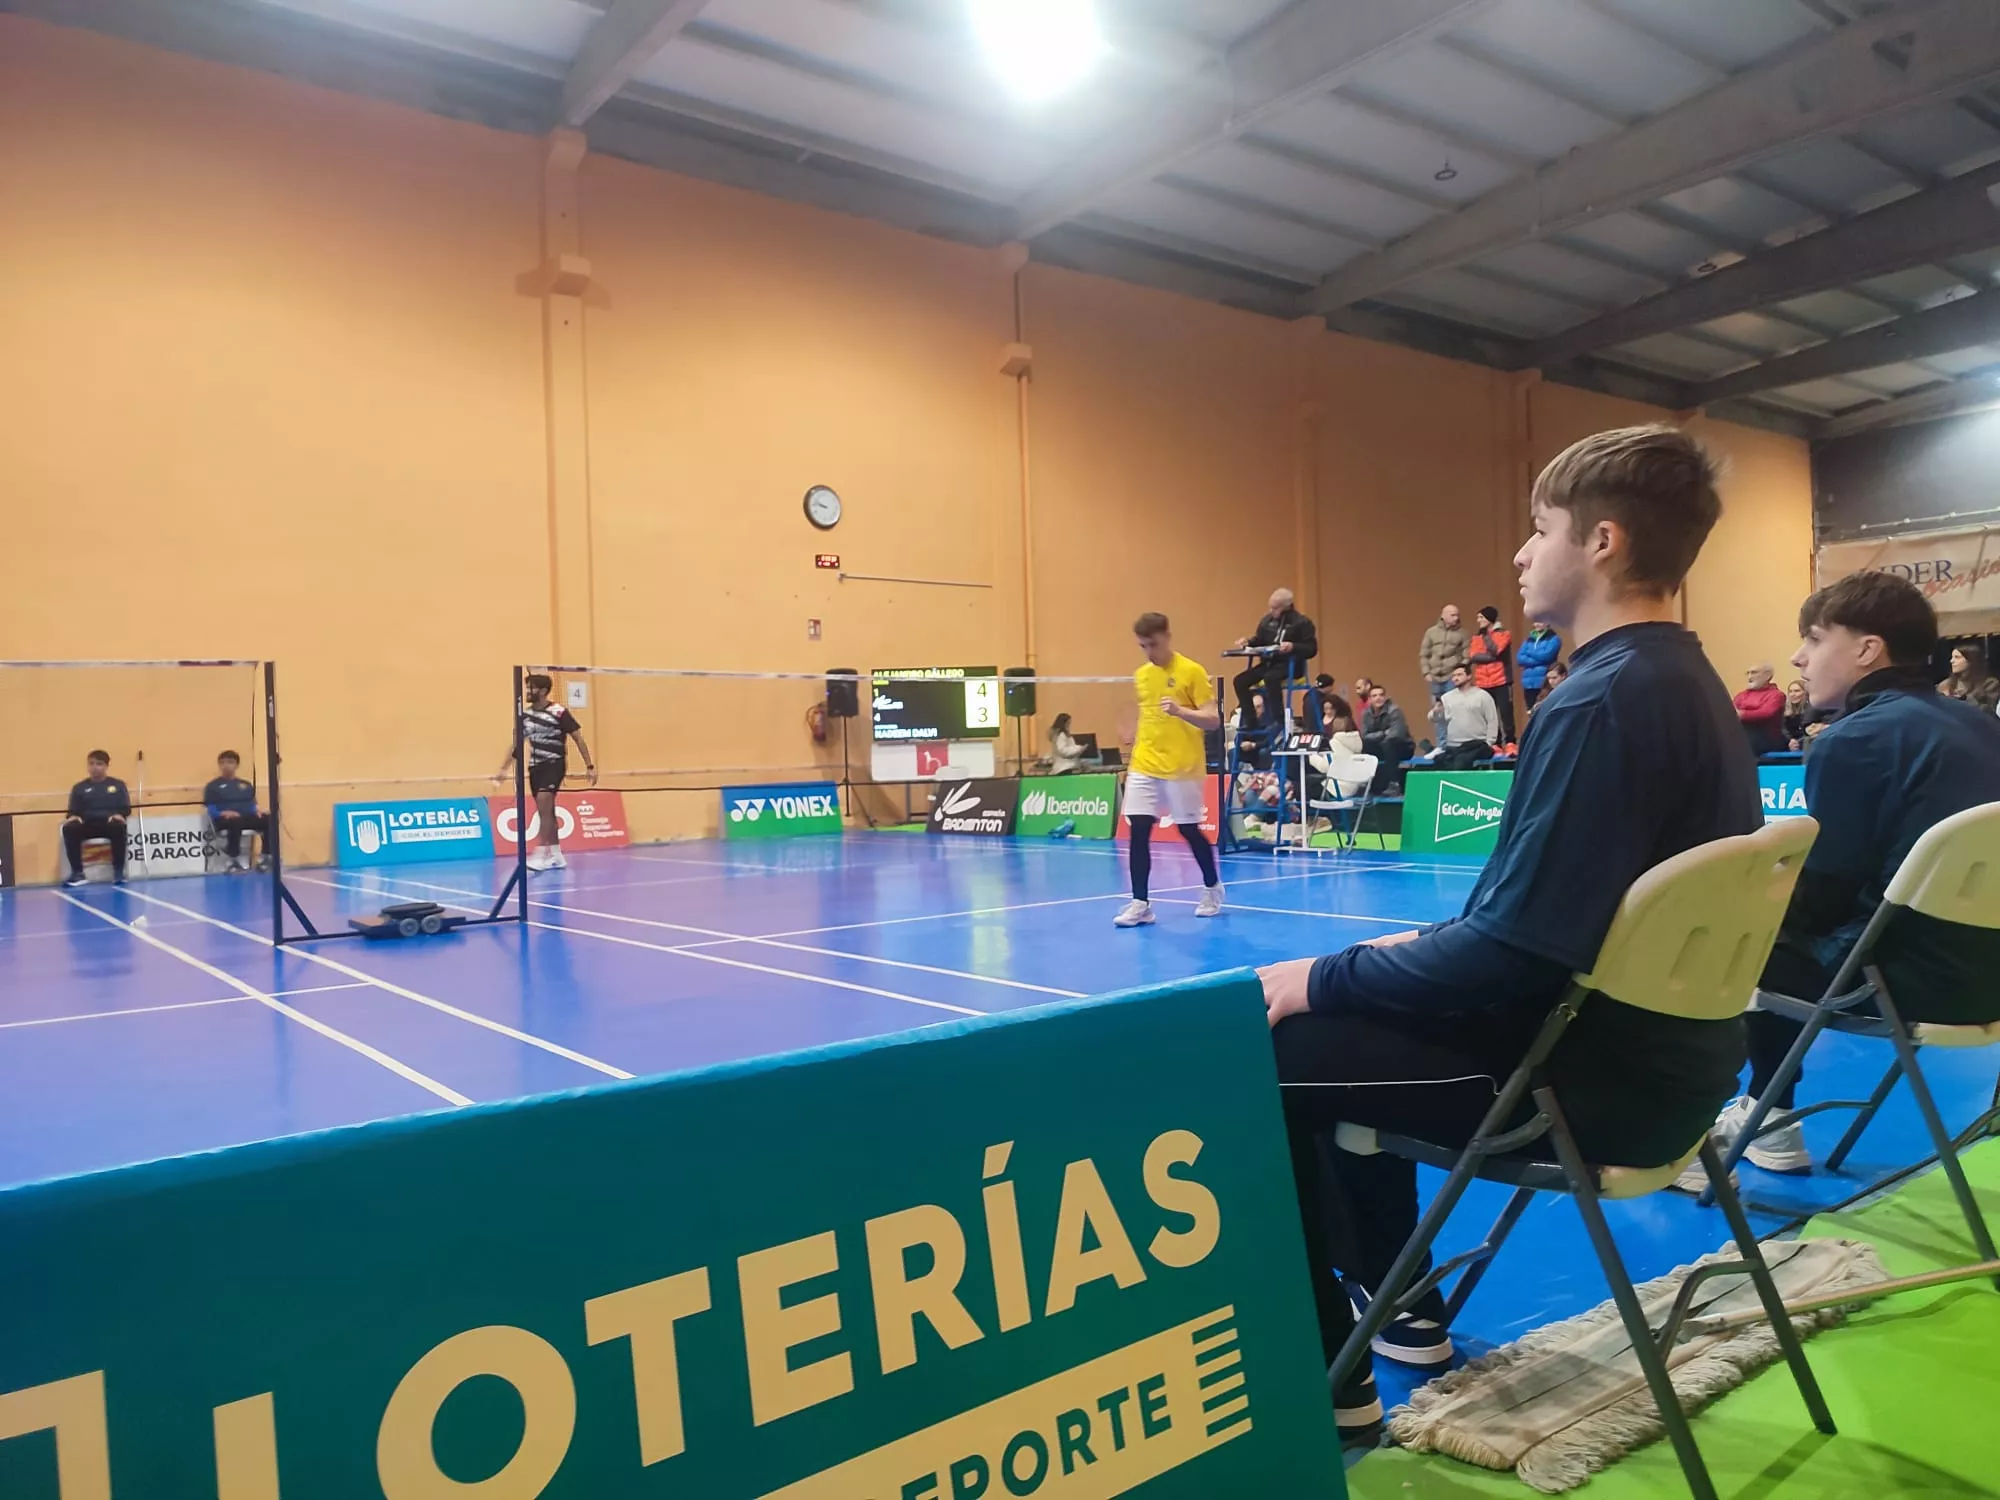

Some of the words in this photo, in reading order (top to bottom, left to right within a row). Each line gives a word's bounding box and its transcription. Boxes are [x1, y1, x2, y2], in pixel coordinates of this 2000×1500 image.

[573, 687, 582, 700] 4
[976, 681, 987, 698] 4
[977, 706, 988, 723] 3
[769, 794, 836, 820] YONEX
[1046, 796, 1109, 816] Iberdrola
[388, 807, 480, 828] LOTERÍAS
